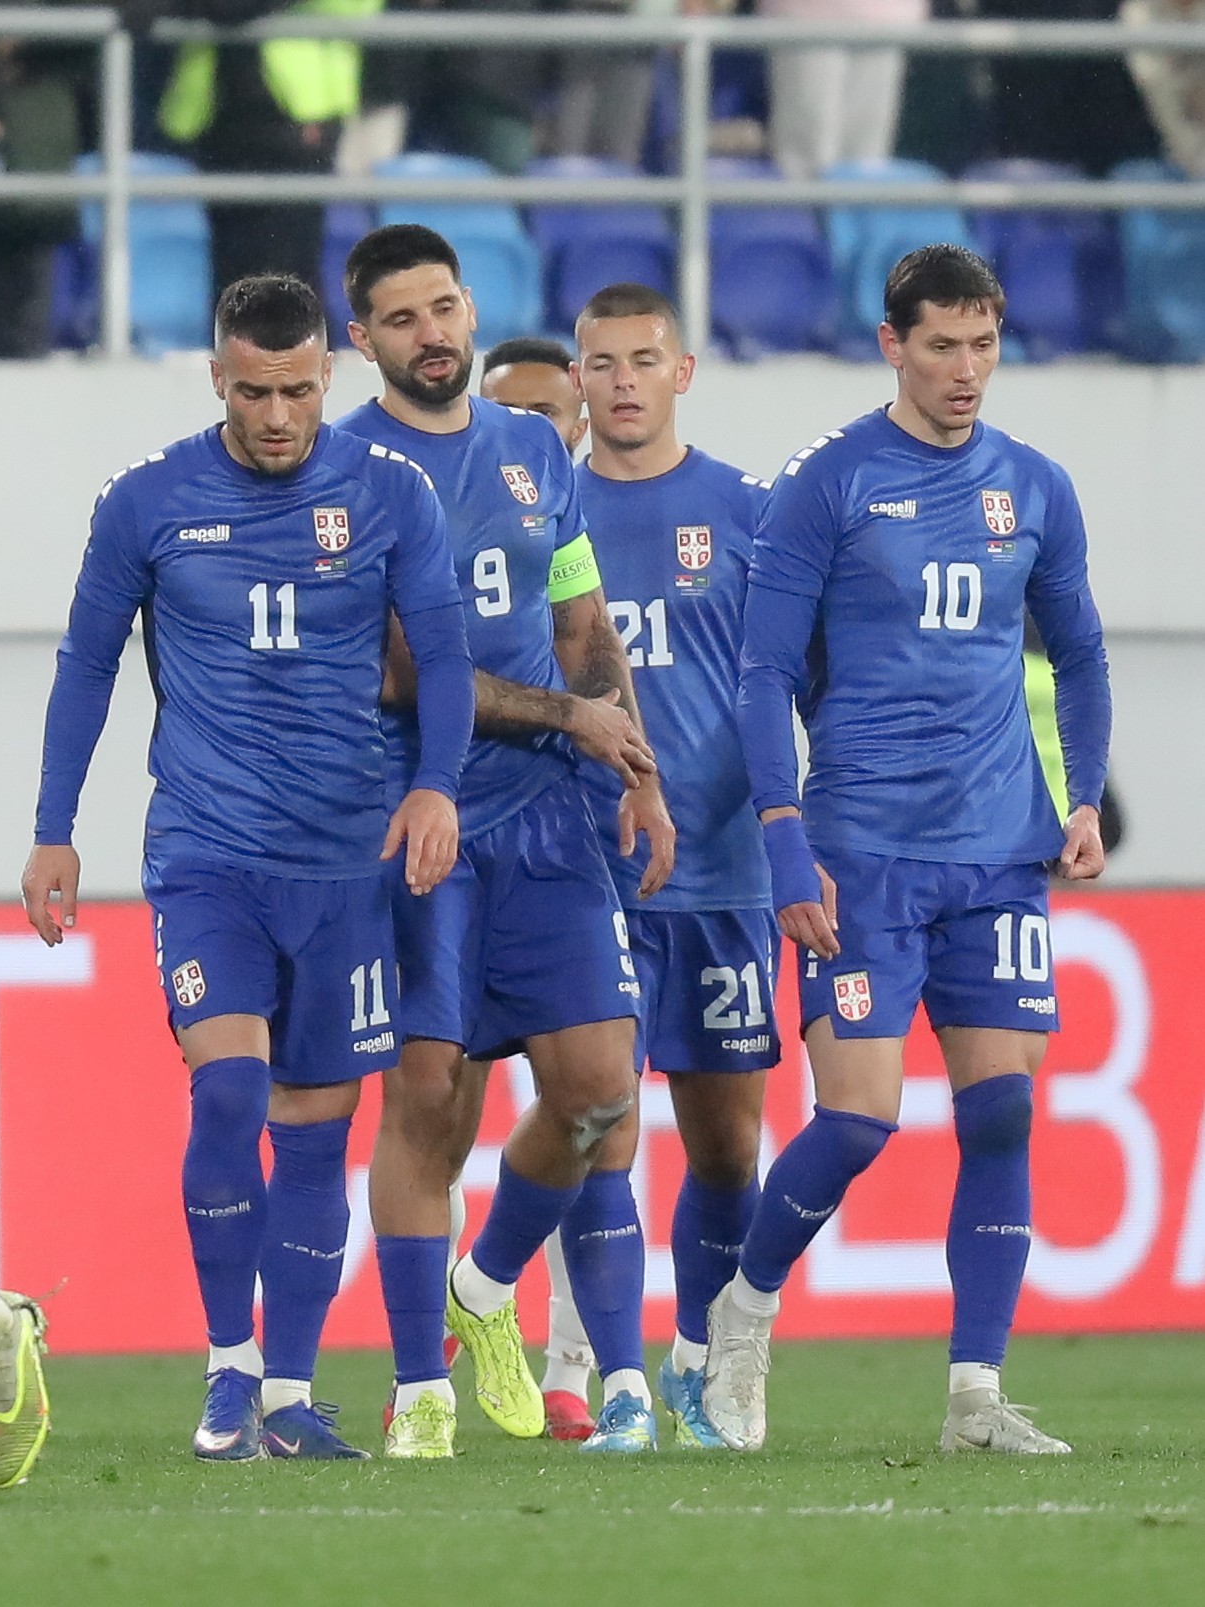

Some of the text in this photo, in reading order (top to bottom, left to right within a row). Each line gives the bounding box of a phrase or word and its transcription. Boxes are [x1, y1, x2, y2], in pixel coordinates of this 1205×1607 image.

[179, 524, 231, 542] capelli
[868, 499, 917, 518] capelli
[472, 547, 512, 618] 9
[552, 555, 594, 582] RESPEC
[919, 561, 982, 631] 10
[248, 582, 300, 649] 11
[605, 598, 674, 667] 21
[993, 913, 1052, 982] 10
[349, 957, 391, 1032] 11
[700, 961, 767, 1029] 21
[353, 1031, 394, 1053] capelli
[721, 1034, 770, 1052] capelli
